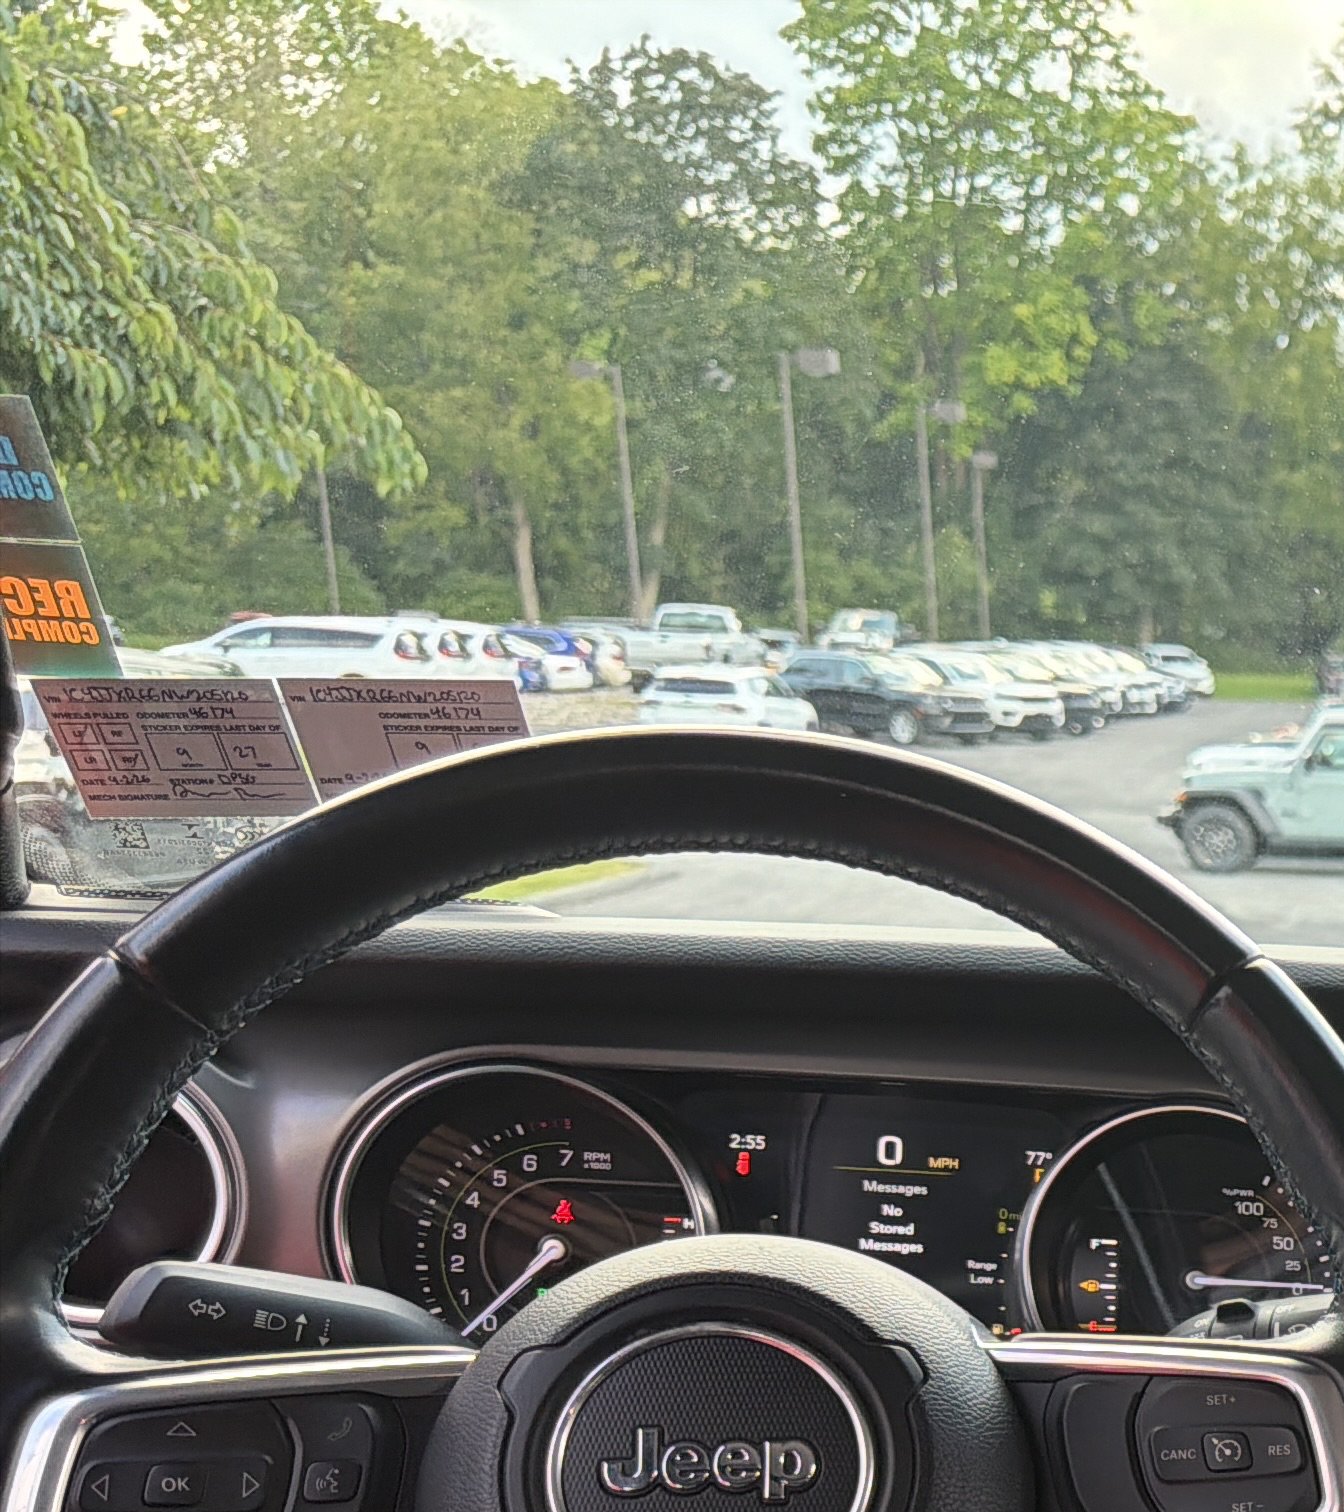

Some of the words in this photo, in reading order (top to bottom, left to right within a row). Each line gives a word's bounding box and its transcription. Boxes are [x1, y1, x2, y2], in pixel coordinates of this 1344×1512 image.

[729, 1134, 766, 1150] 2:55
[583, 1152, 612, 1162] RPM
[876, 1135, 903, 1165] 0
[523, 1154, 538, 1172] 6
[559, 1149, 573, 1167] 7
[928, 1157, 959, 1170] MPH
[493, 1170, 507, 1187] 5
[862, 1181, 928, 1196] Messages
[465, 1191, 480, 1209] 4
[881, 1203, 903, 1217] No
[1234, 1202, 1264, 1215] 100
[683, 1218, 695, 1230] H
[868, 1221, 915, 1236] Stored
[1262, 1218, 1278, 1228] 75
[452, 1223, 466, 1240] 3
[859, 1239, 924, 1254] Messages
[1089, 1239, 1100, 1250] F
[1273, 1237, 1294, 1250] 50
[451, 1255, 464, 1273] 2
[966, 1260, 998, 1271] Range
[1285, 1261, 1301, 1271] 25
[970, 1274, 994, 1284] Low
[460, 1289, 470, 1305] 1
[482, 1315, 497, 1332] 0
[1161, 1449, 1197, 1461] CANC
[1268, 1445, 1290, 1456] RES
[601, 1426, 818, 1500] Jeep
[161, 1476, 190, 1493] OK
